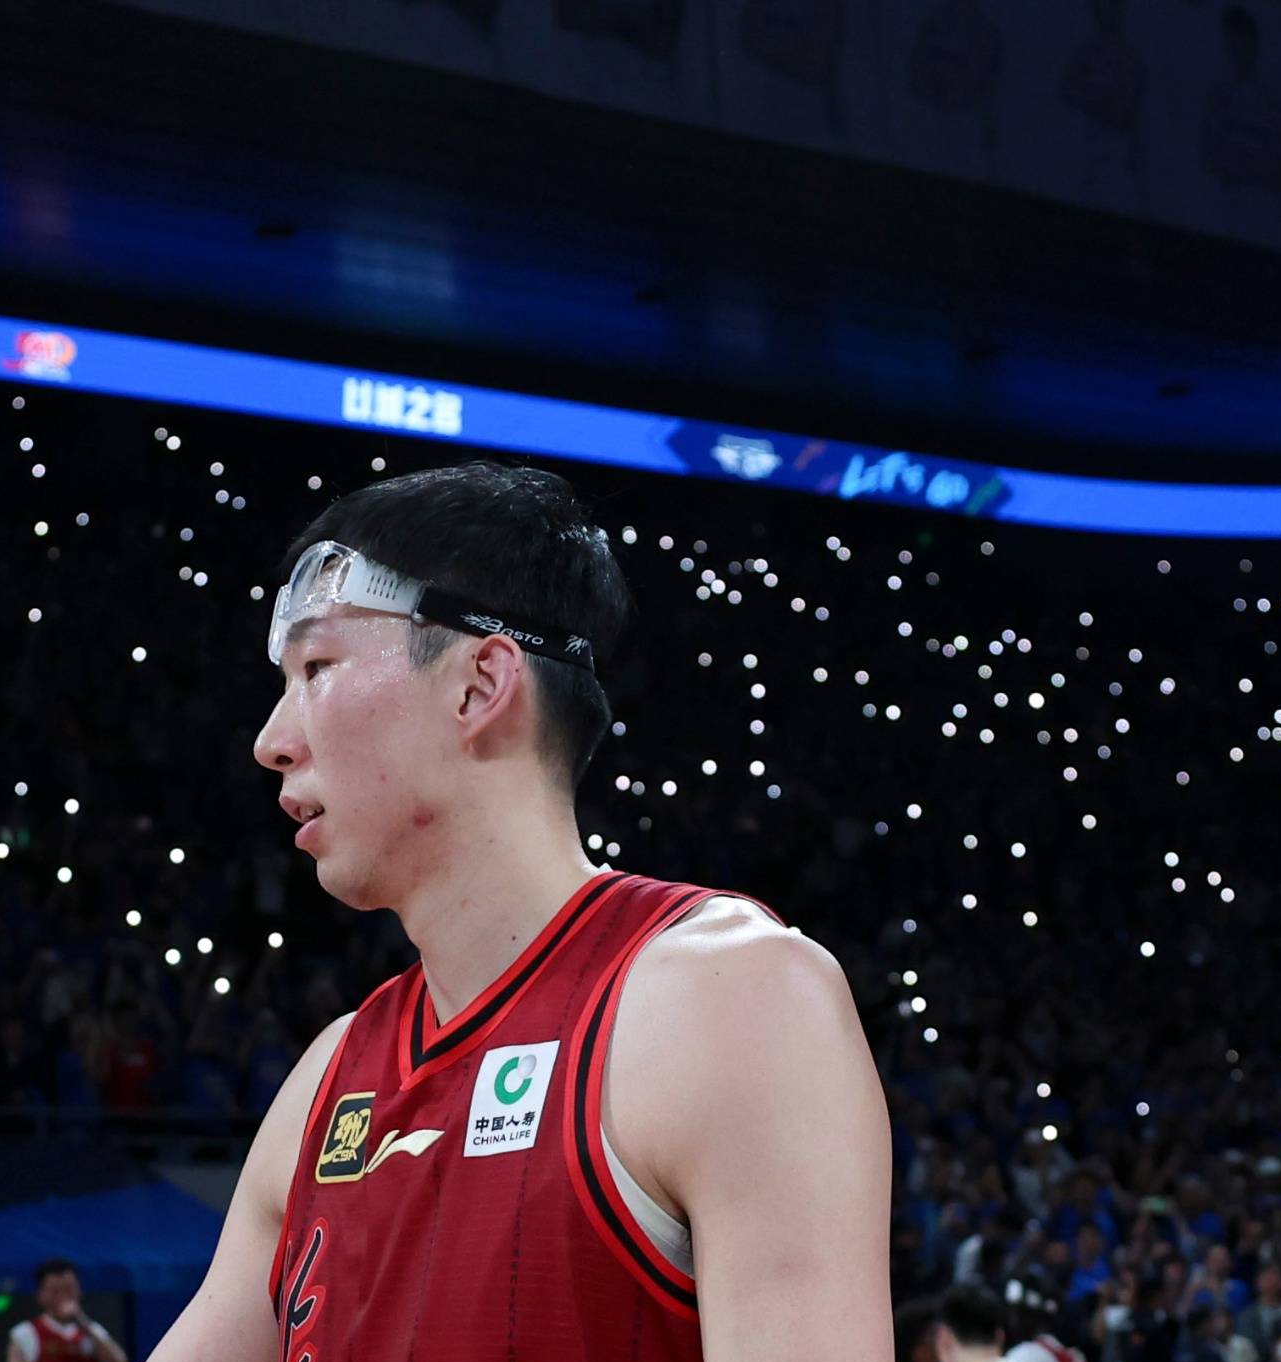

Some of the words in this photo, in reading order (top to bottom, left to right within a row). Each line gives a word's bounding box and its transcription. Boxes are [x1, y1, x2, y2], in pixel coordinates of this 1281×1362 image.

[474, 1111, 536, 1133] 中国人寿
[472, 1135, 506, 1147] CHINA
[509, 1129, 532, 1142] LIFE
